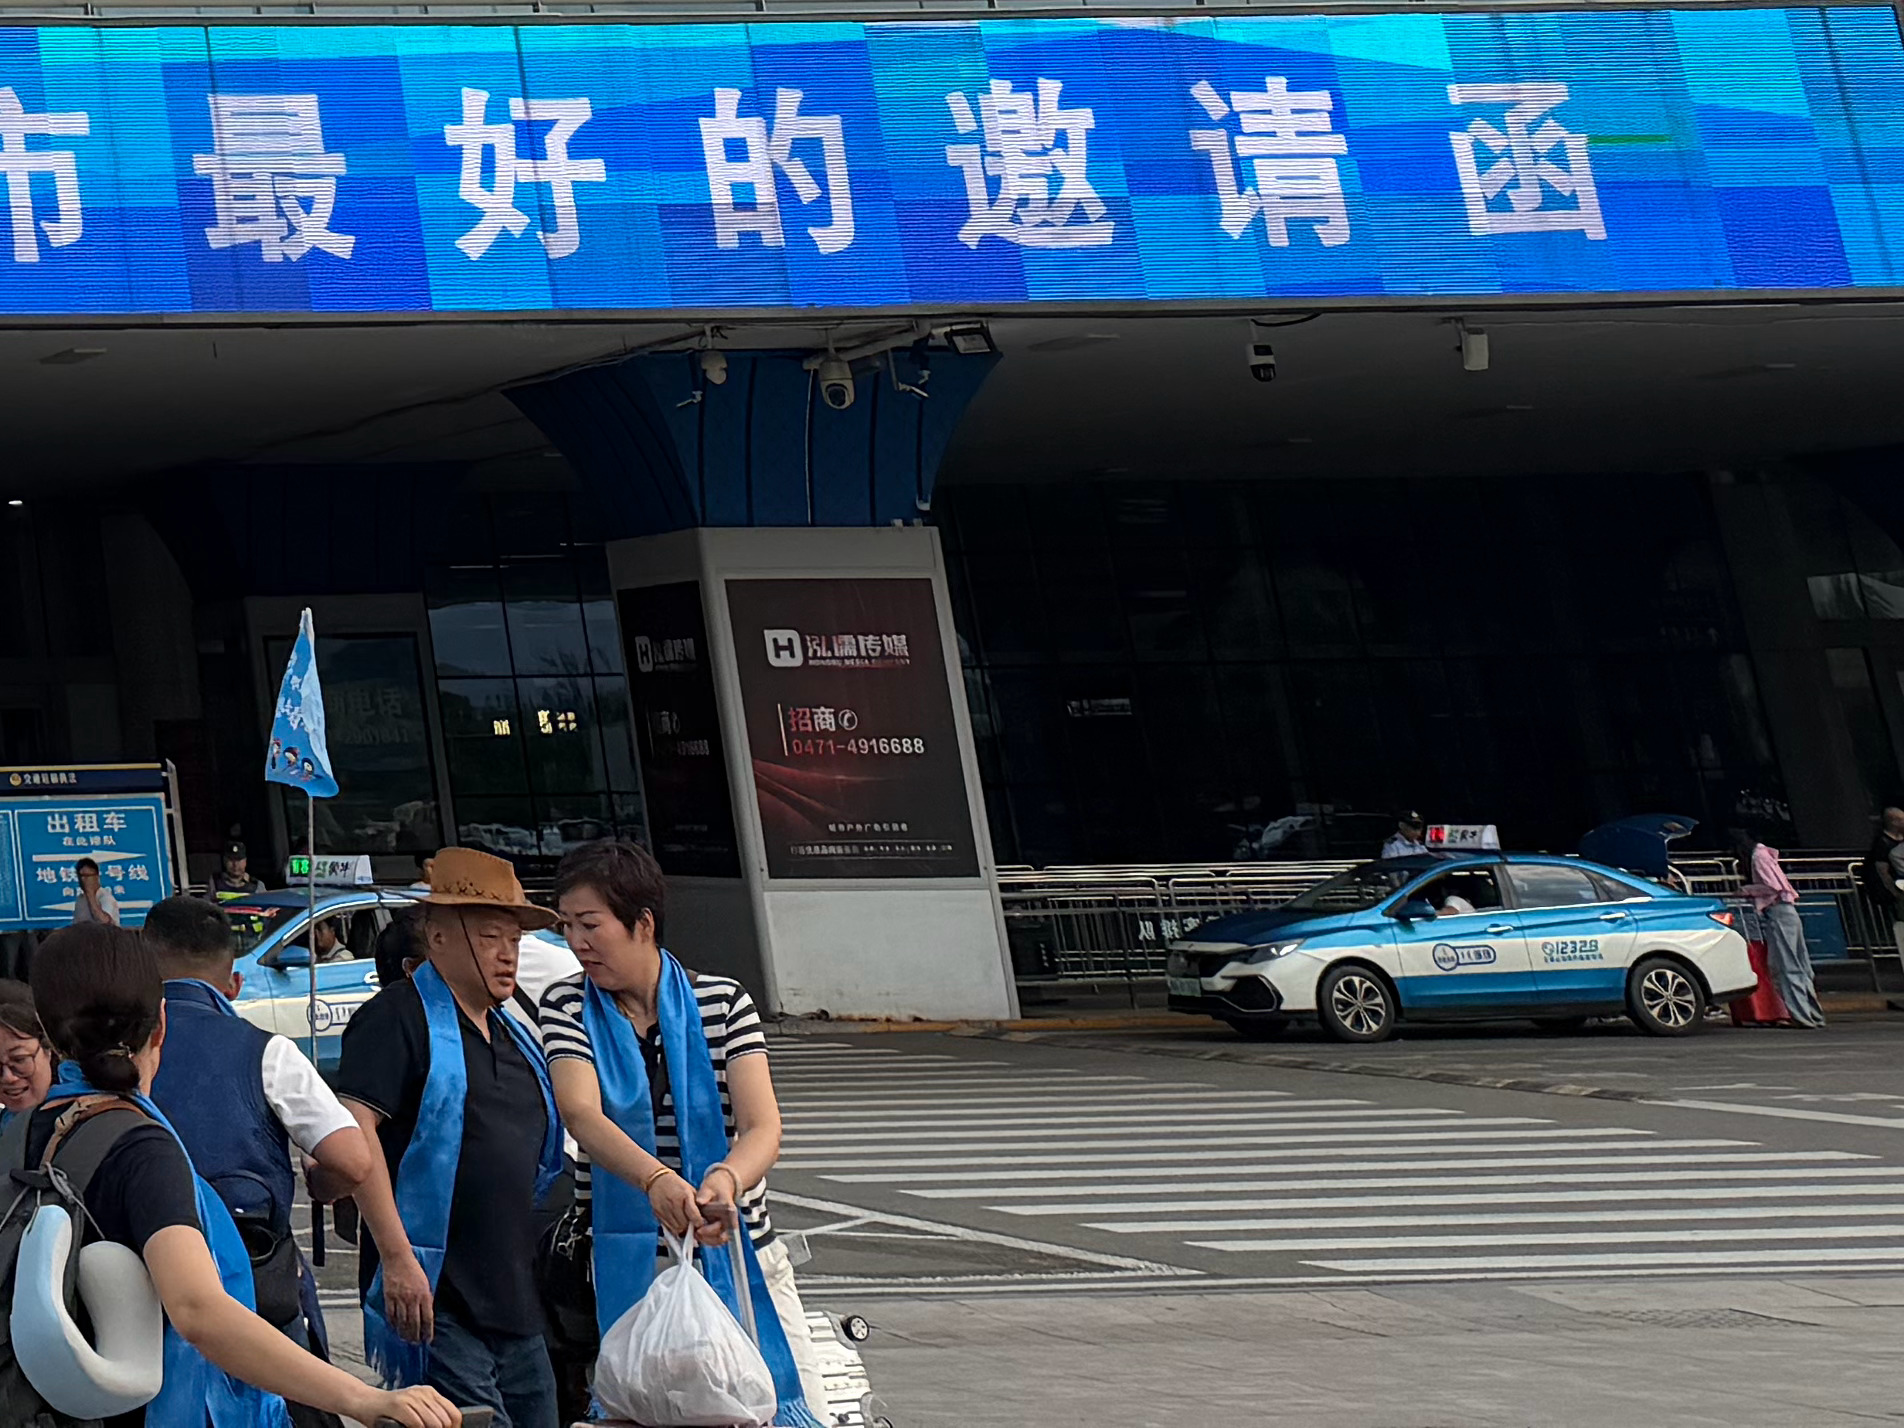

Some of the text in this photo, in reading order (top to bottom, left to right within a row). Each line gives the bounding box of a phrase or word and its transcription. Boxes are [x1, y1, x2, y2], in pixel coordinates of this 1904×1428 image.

[788, 706, 837, 732] 招商
[793, 738, 925, 756] 0471-4916688
[47, 812, 127, 834] 出租车
[36, 864, 150, 884] 地铁号线
[1555, 939, 1599, 955] 12328
